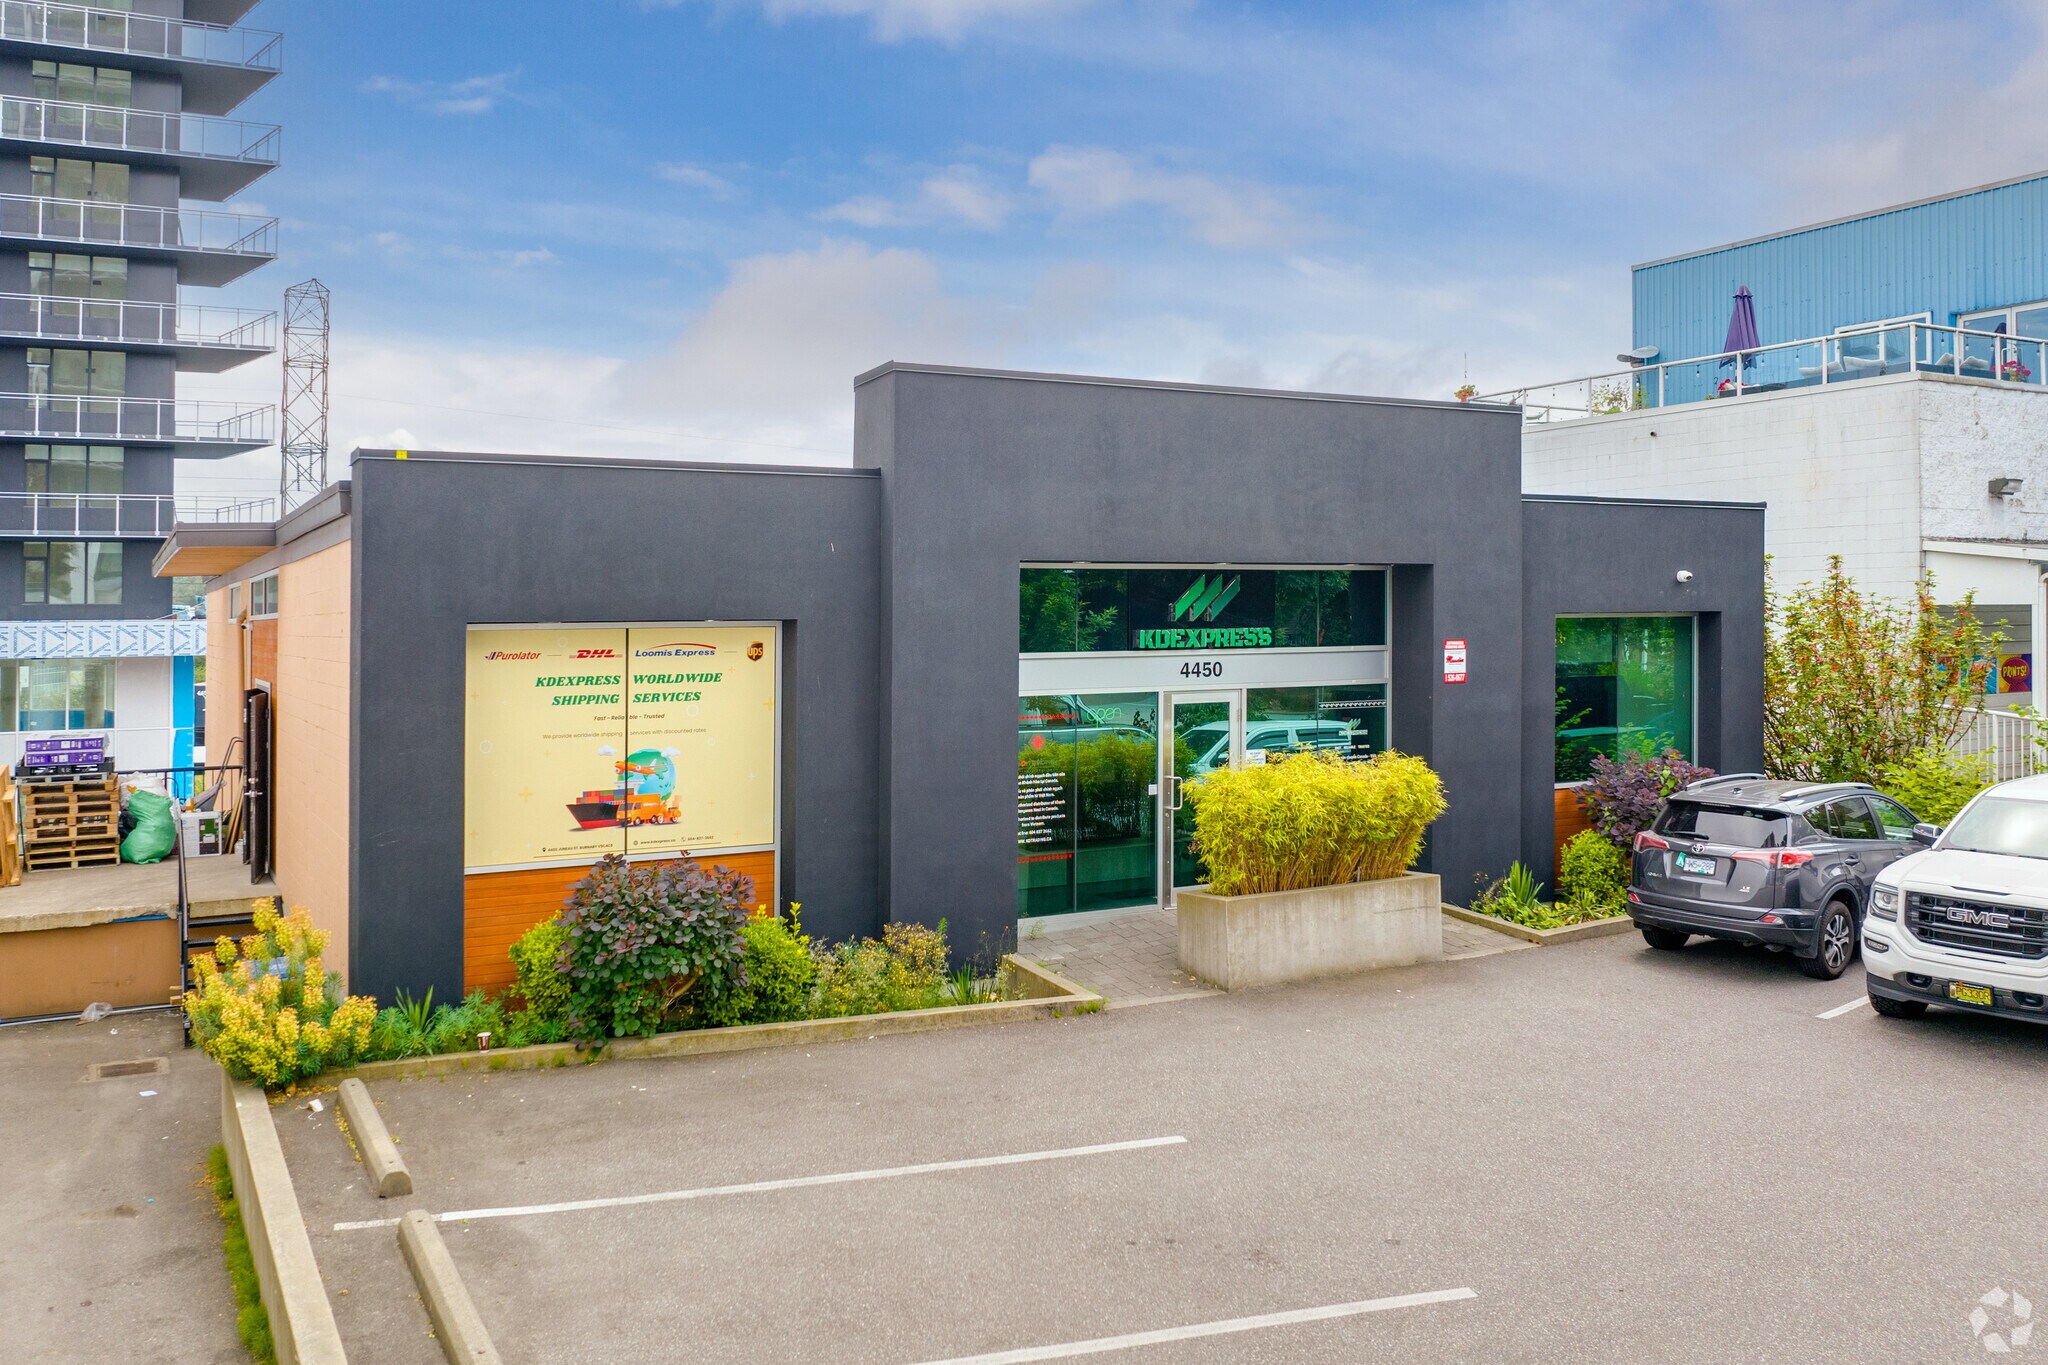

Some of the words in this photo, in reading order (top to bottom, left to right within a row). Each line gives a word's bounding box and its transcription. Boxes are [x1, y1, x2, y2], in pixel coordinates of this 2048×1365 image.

[1138, 627, 1272, 648] KDEXPRESS
[494, 651, 542, 660] Purolator
[576, 649, 615, 659] DHL
[635, 649, 672, 657] Loomis
[674, 648, 716, 657] Express
[748, 645, 763, 659] ups
[1180, 661, 1223, 678] 4450
[535, 674, 621, 688] KDEXPRESS
[633, 672, 723, 685] WORLDWIDE
[552, 694, 620, 706] SHIPPING
[632, 691, 702, 703] SERVICES
[1947, 907, 2010, 928] GMC
